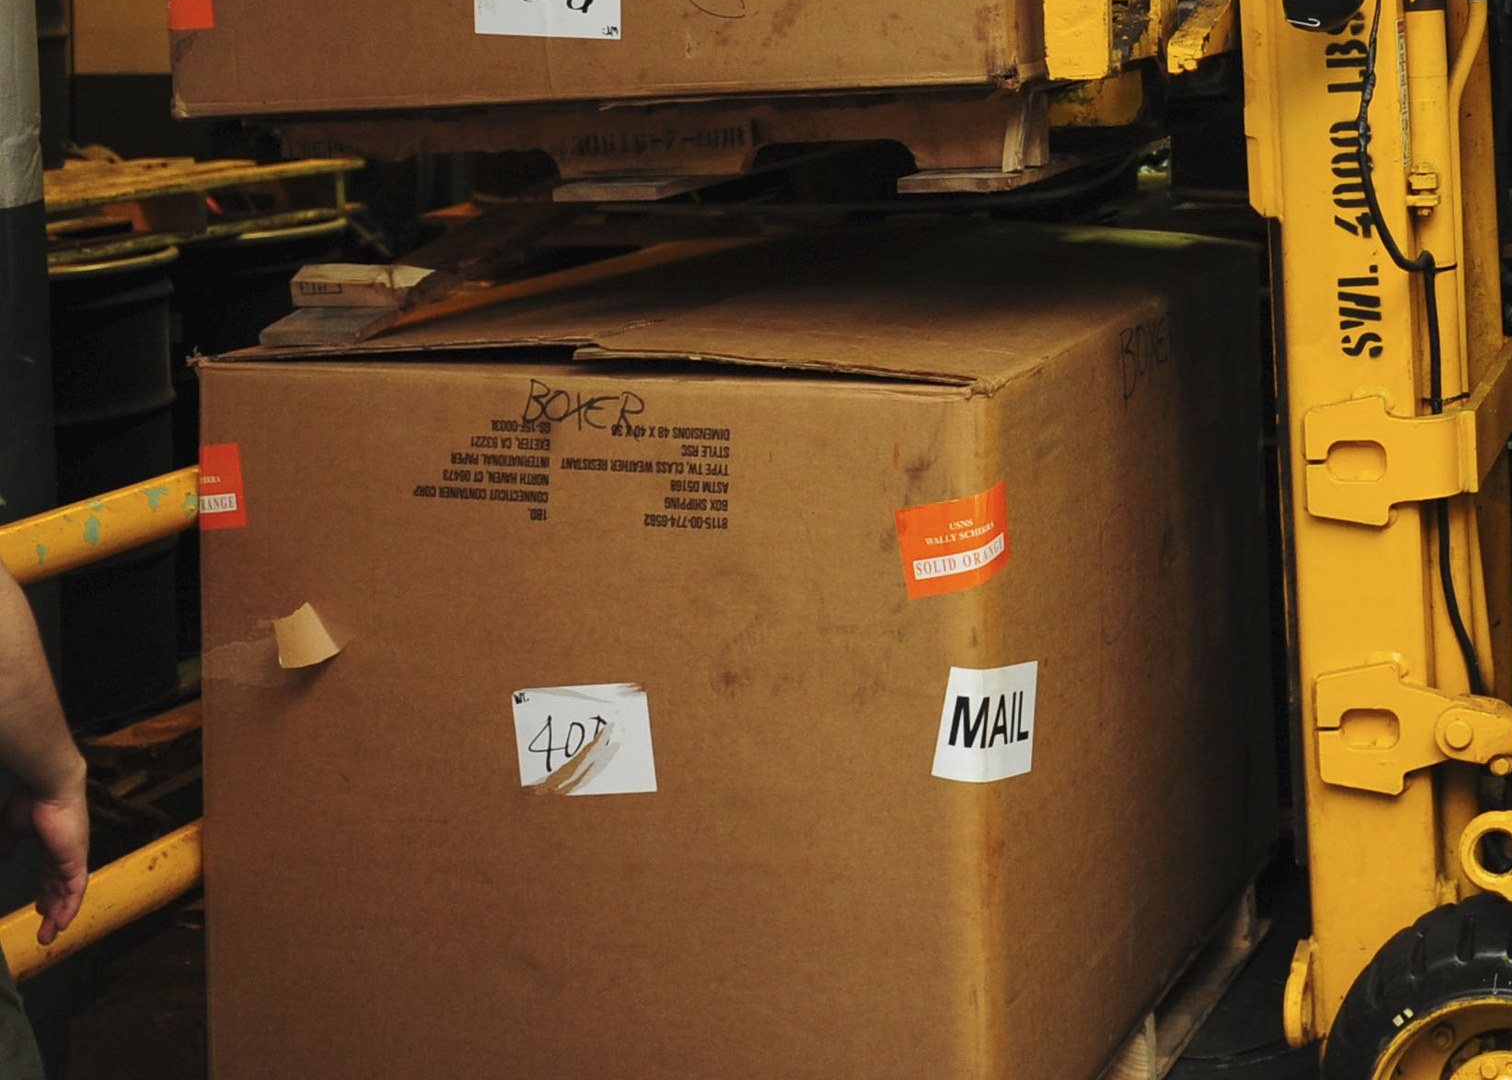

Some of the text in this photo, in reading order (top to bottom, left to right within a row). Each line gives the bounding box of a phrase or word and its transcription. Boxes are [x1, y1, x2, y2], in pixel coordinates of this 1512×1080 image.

[521, 378, 645, 441] BOXER
[658, 427, 670, 438] 48
[672, 427, 730, 441] DIMENSIONS
[470, 436, 498, 448] 93221
[500, 437, 513, 449] CA
[680, 444, 730, 458] STYLE RSC
[450, 452, 550, 468] INTERNATIONAL PAPER
[560, 457, 608, 471] RESISTANT
[611, 459, 653, 473] WEATHER
[655, 461, 684, 474] CLASS
[705, 463, 729, 476] TYPE
[472, 471, 483, 483] CT
[520, 473, 549, 486] NORTH
[438, 486, 487, 500] CONTAINER
[702, 480, 729, 494] ASTM
[489, 489, 549, 503] CONNECTICUT
[664, 497, 728, 511] BOX SHIPPING
[949, 518, 974, 531] USNS
[925, 533, 957, 546] WALLY
[915, 538, 1004, 577] SOLID ORANGE
[947, 690, 1030, 749] MAIL
